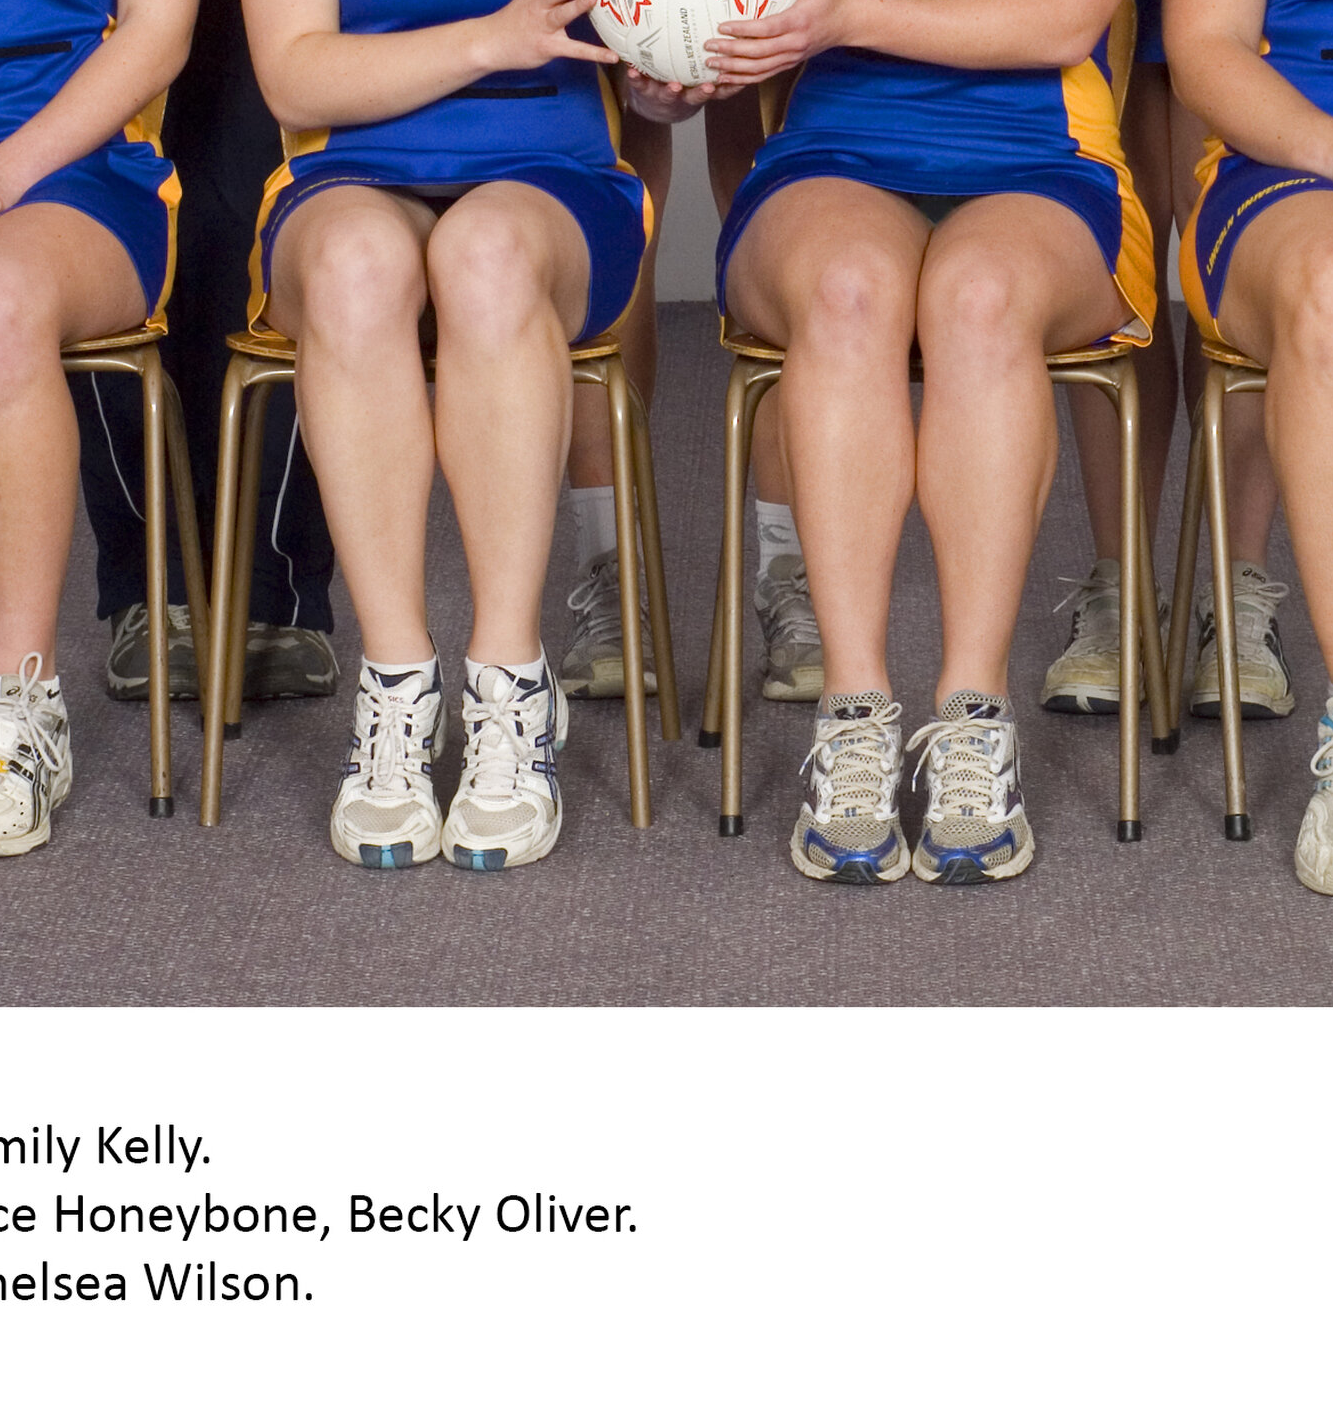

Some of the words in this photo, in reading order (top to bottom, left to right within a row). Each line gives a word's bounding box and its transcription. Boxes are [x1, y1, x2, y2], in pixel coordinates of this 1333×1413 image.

[679, 7, 692, 43] ZEALAND
[1206, 214, 1234, 276] LINCOLN
[1237, 178, 1317, 216] UNIVERSITY
